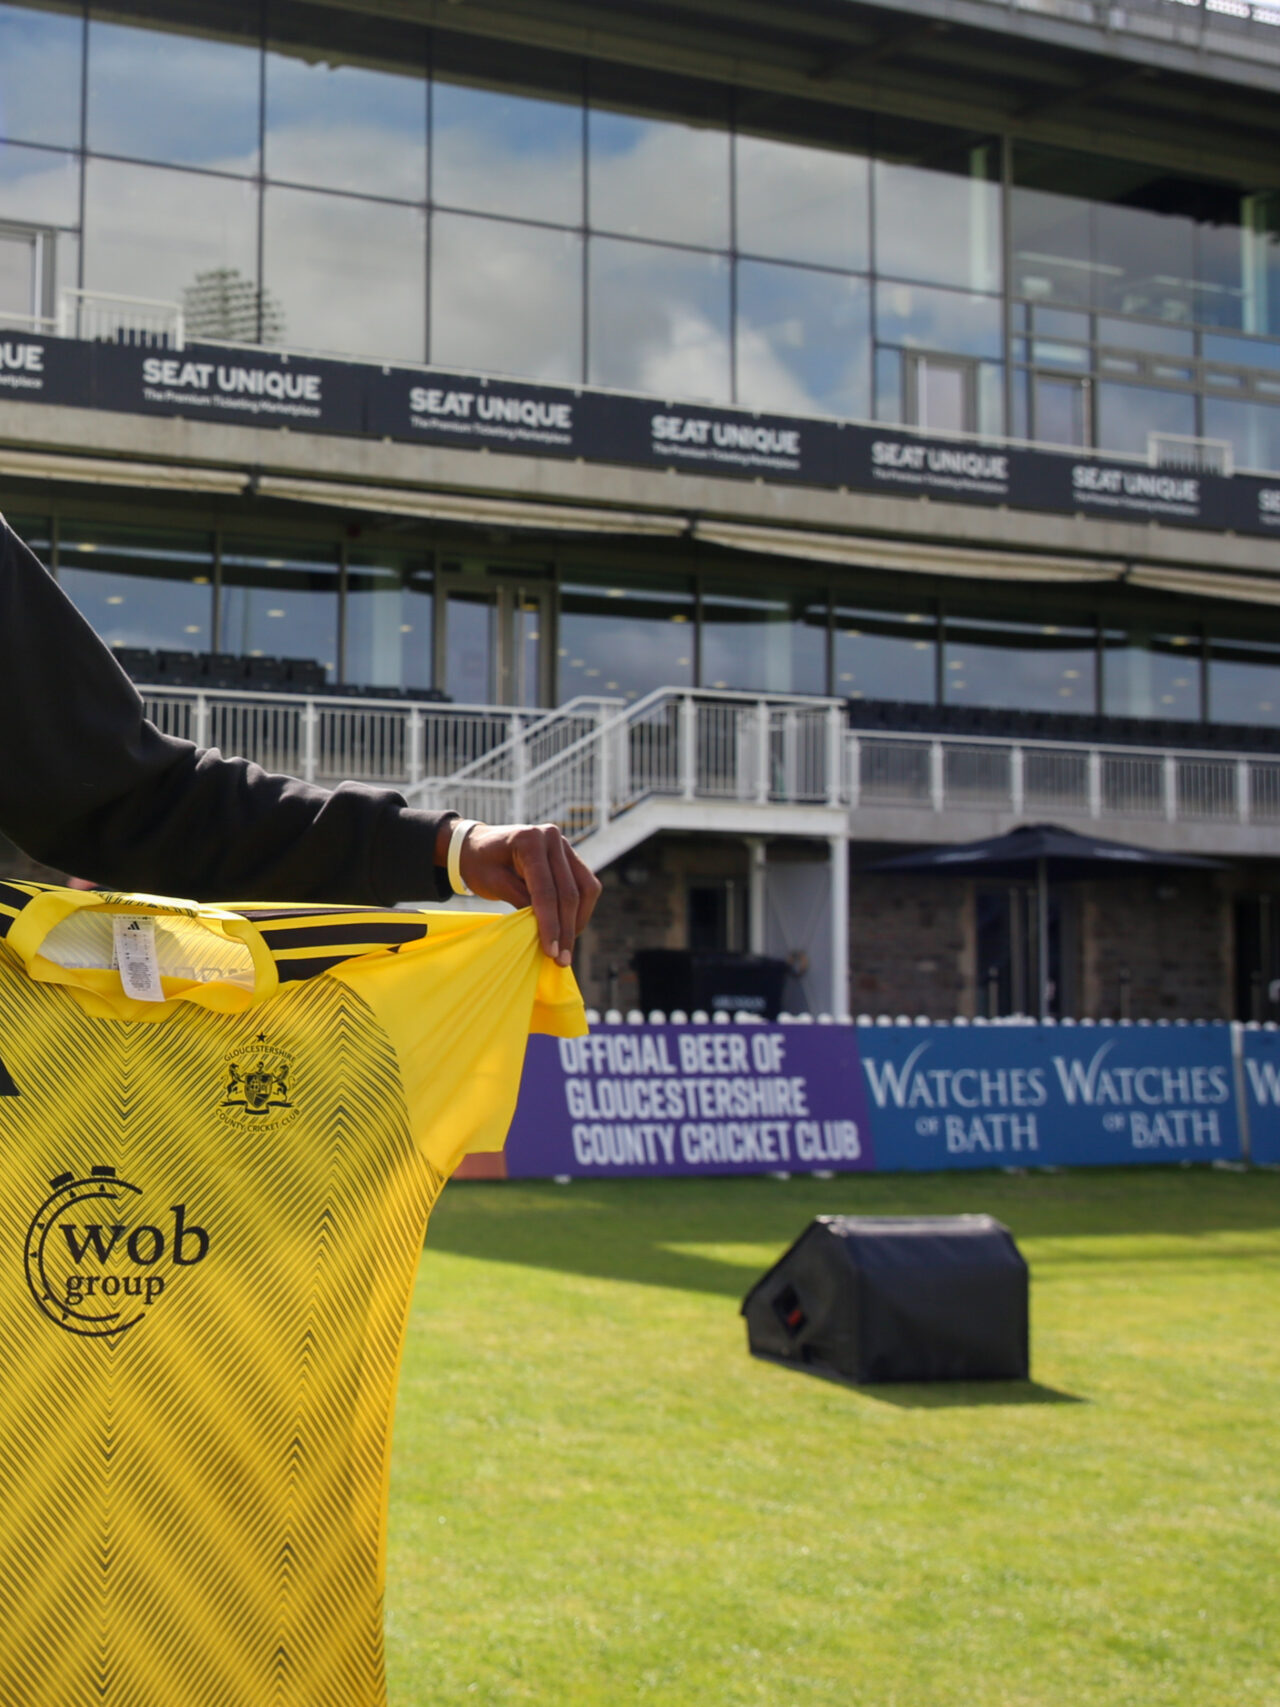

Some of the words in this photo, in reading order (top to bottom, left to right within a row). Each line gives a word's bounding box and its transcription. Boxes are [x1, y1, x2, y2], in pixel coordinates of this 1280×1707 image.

[143, 358, 214, 389] SEAT
[218, 366, 321, 400] UNIQUE
[409, 387, 474, 417] SEAT
[477, 395, 572, 428] UNIQUE
[651, 415, 711, 444] SEAT
[712, 422, 800, 455] UNIQUE
[872, 441, 926, 470] SEAT
[927, 449, 1009, 479] UNIQUE
[1072, 465, 1122, 492] SEAT
[1123, 473, 1200, 503] UNIQUE
[224, 1045, 295, 1061] GLOUCESTERSHIRE
[558, 1034, 677, 1075] OFFICIAL
[678, 1033, 749, 1073] BEER
[752, 1033, 785, 1072] OF
[1051, 1039, 1229, 1105] WATCHES
[861, 1039, 1048, 1109] WATCHES
[565, 1077, 808, 1120] GLOUCESTERSHIRE
[215, 1108, 243, 1130] COUNTY
[247, 1122, 278, 1132] CRICKET
[281, 1108, 300, 1126] CLUB
[915, 1117, 939, 1136] OF
[945, 1113, 1039, 1153] BATH
[1130, 1110, 1220, 1148] BATH
[572, 1122, 675, 1165] COUNTY
[680, 1121, 791, 1163] CRICKET
[795, 1119, 860, 1160] CLUB
[59, 1204, 210, 1266] wob
[64, 1275, 165, 1305] group
